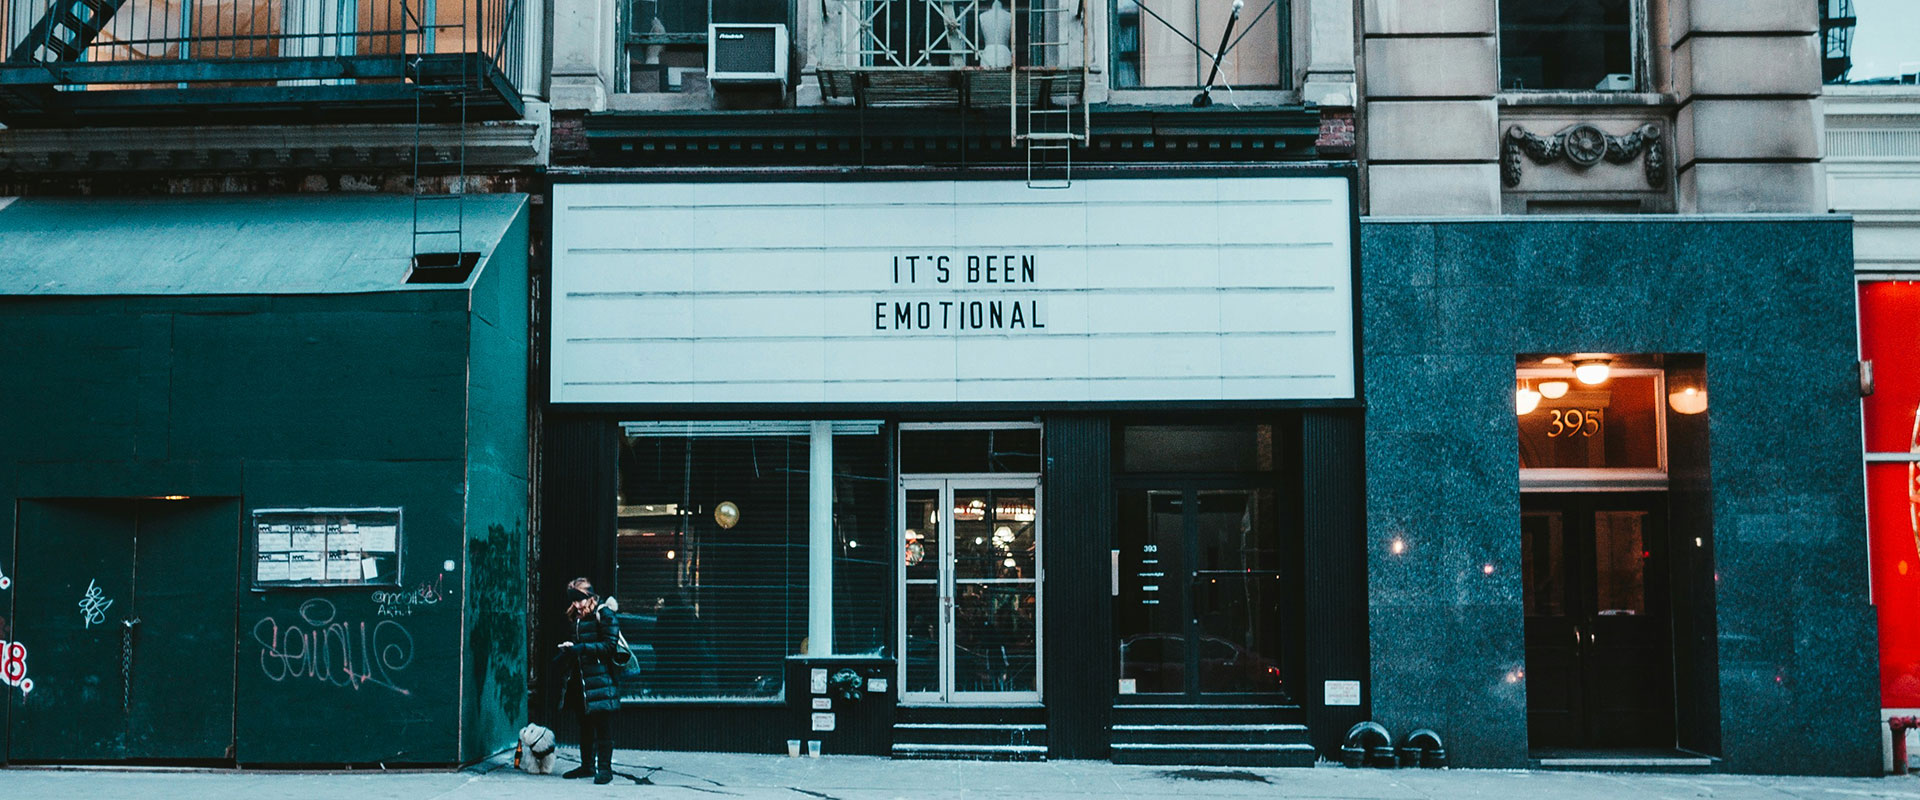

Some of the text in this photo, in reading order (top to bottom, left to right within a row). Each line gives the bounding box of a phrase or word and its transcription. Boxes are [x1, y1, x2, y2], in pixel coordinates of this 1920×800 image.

[893, 255, 1035, 283] IT'S BEEN
[875, 300, 1045, 330] EMOTIONAL
[1547, 409, 1599, 438] 395
[1143, 544, 1158, 553] 393
